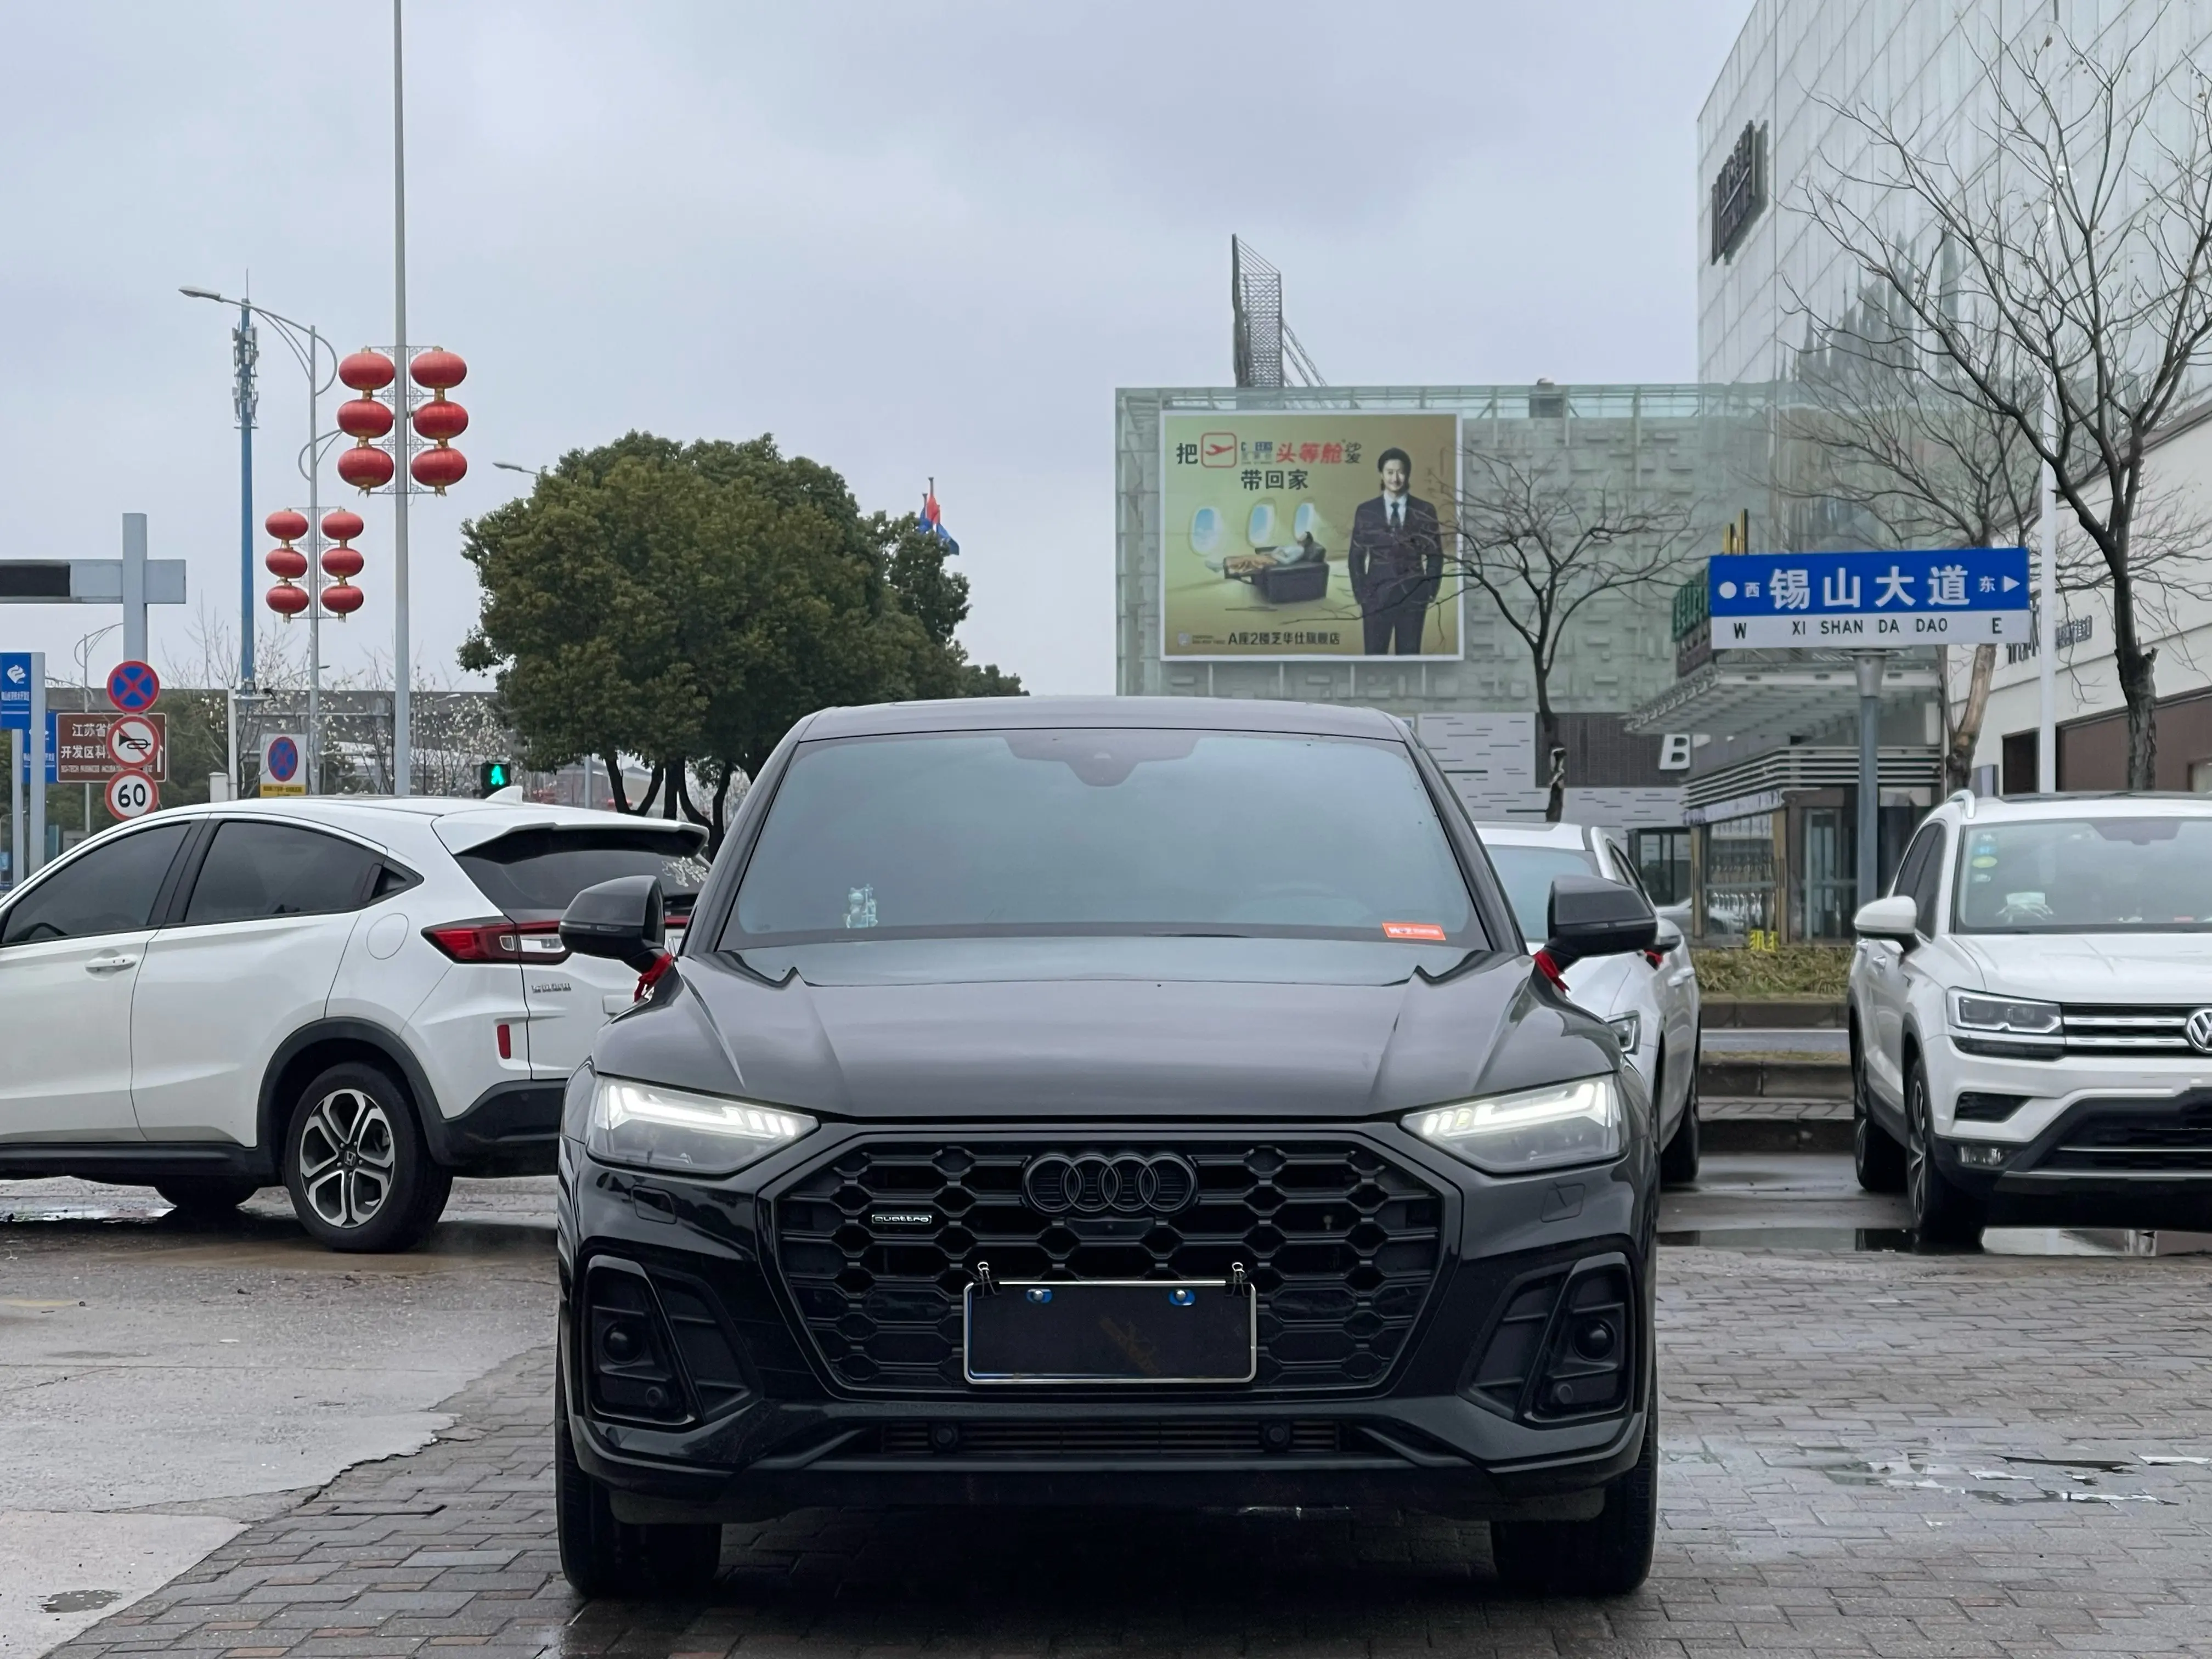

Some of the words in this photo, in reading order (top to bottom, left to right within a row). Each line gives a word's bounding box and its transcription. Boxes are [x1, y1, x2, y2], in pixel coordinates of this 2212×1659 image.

[1176, 443, 1199, 465] 把
[1240, 469, 1308, 491] 带回家
[1745, 582, 1760, 598] 西
[1769, 565, 1971, 610] 锡山大道
[1979, 576, 1995, 593] 东
[1733, 623, 1747, 639] W
[1792, 620, 1806, 636] XI
[1820, 619, 1864, 635] SHAN
[1878, 619, 1900, 634] DA
[1916, 617, 1948, 633] DAO
[1992, 617, 2002, 634] E
[72, 723, 112, 737] 江苏省
[60, 744, 111, 759] 开发区科
[117, 783, 146, 808] 60
